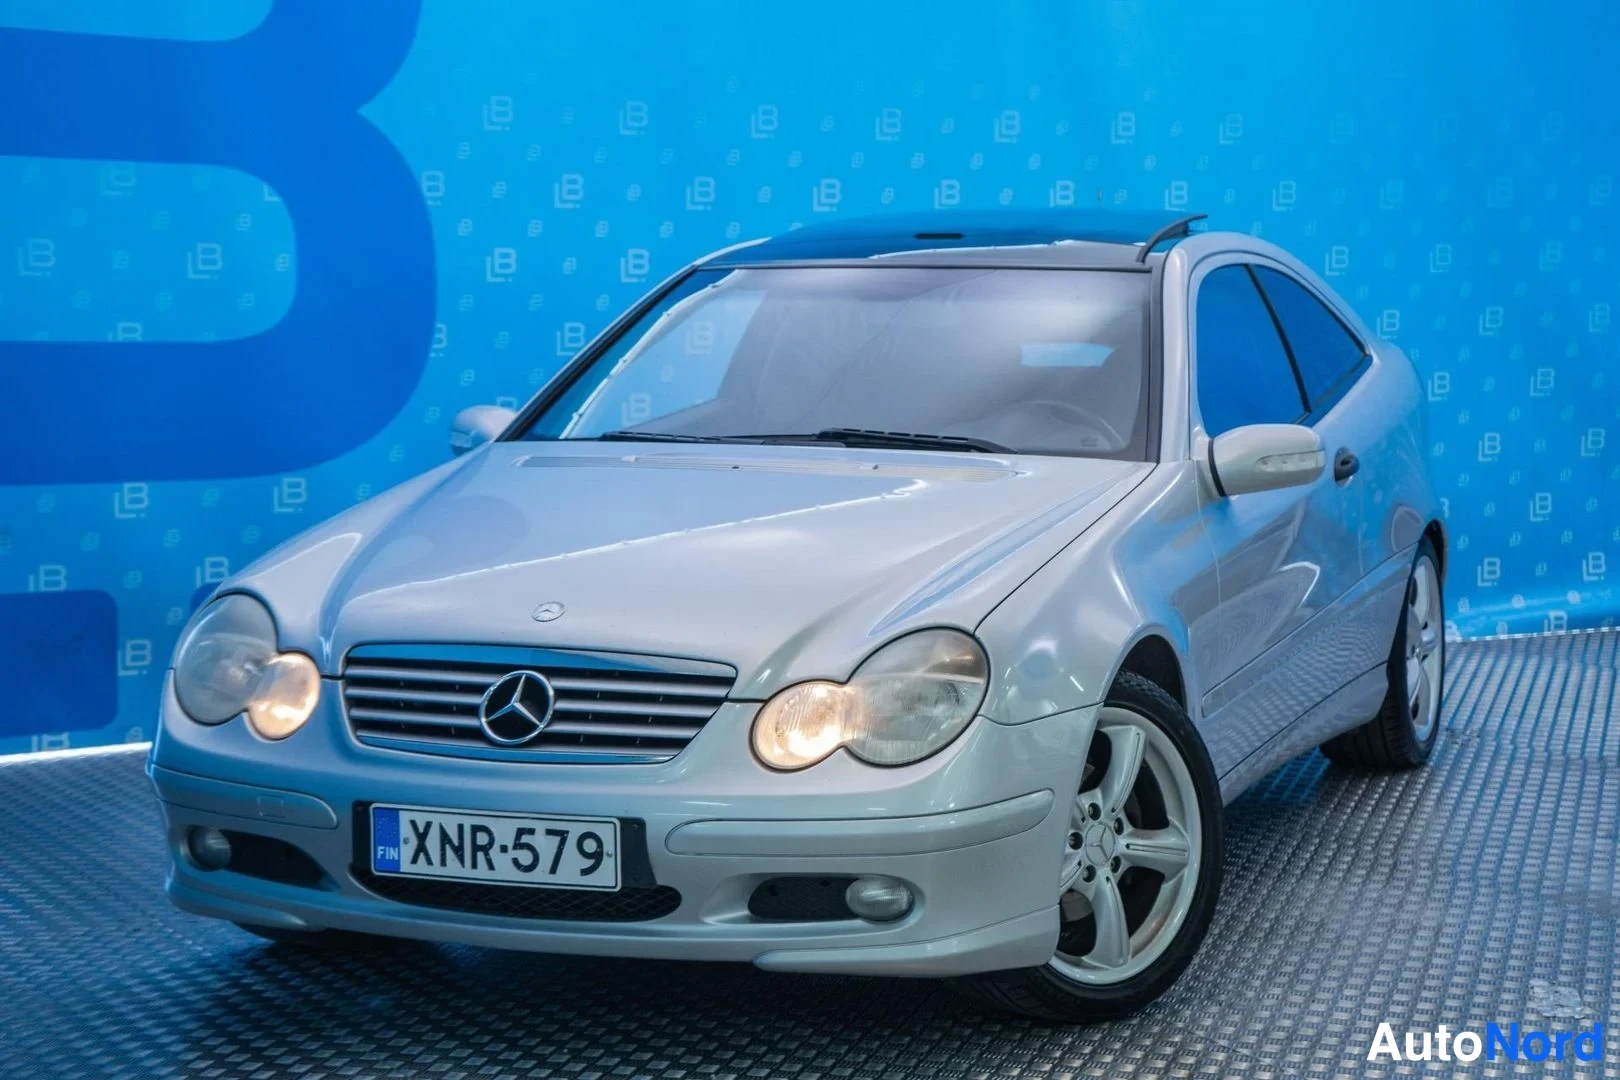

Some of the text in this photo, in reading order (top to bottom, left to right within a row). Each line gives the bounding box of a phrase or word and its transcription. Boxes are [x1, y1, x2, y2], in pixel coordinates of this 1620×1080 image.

[421, 170, 445, 206] B
[377, 845, 399, 861] FIN
[409, 819, 605, 877] XNR-579
